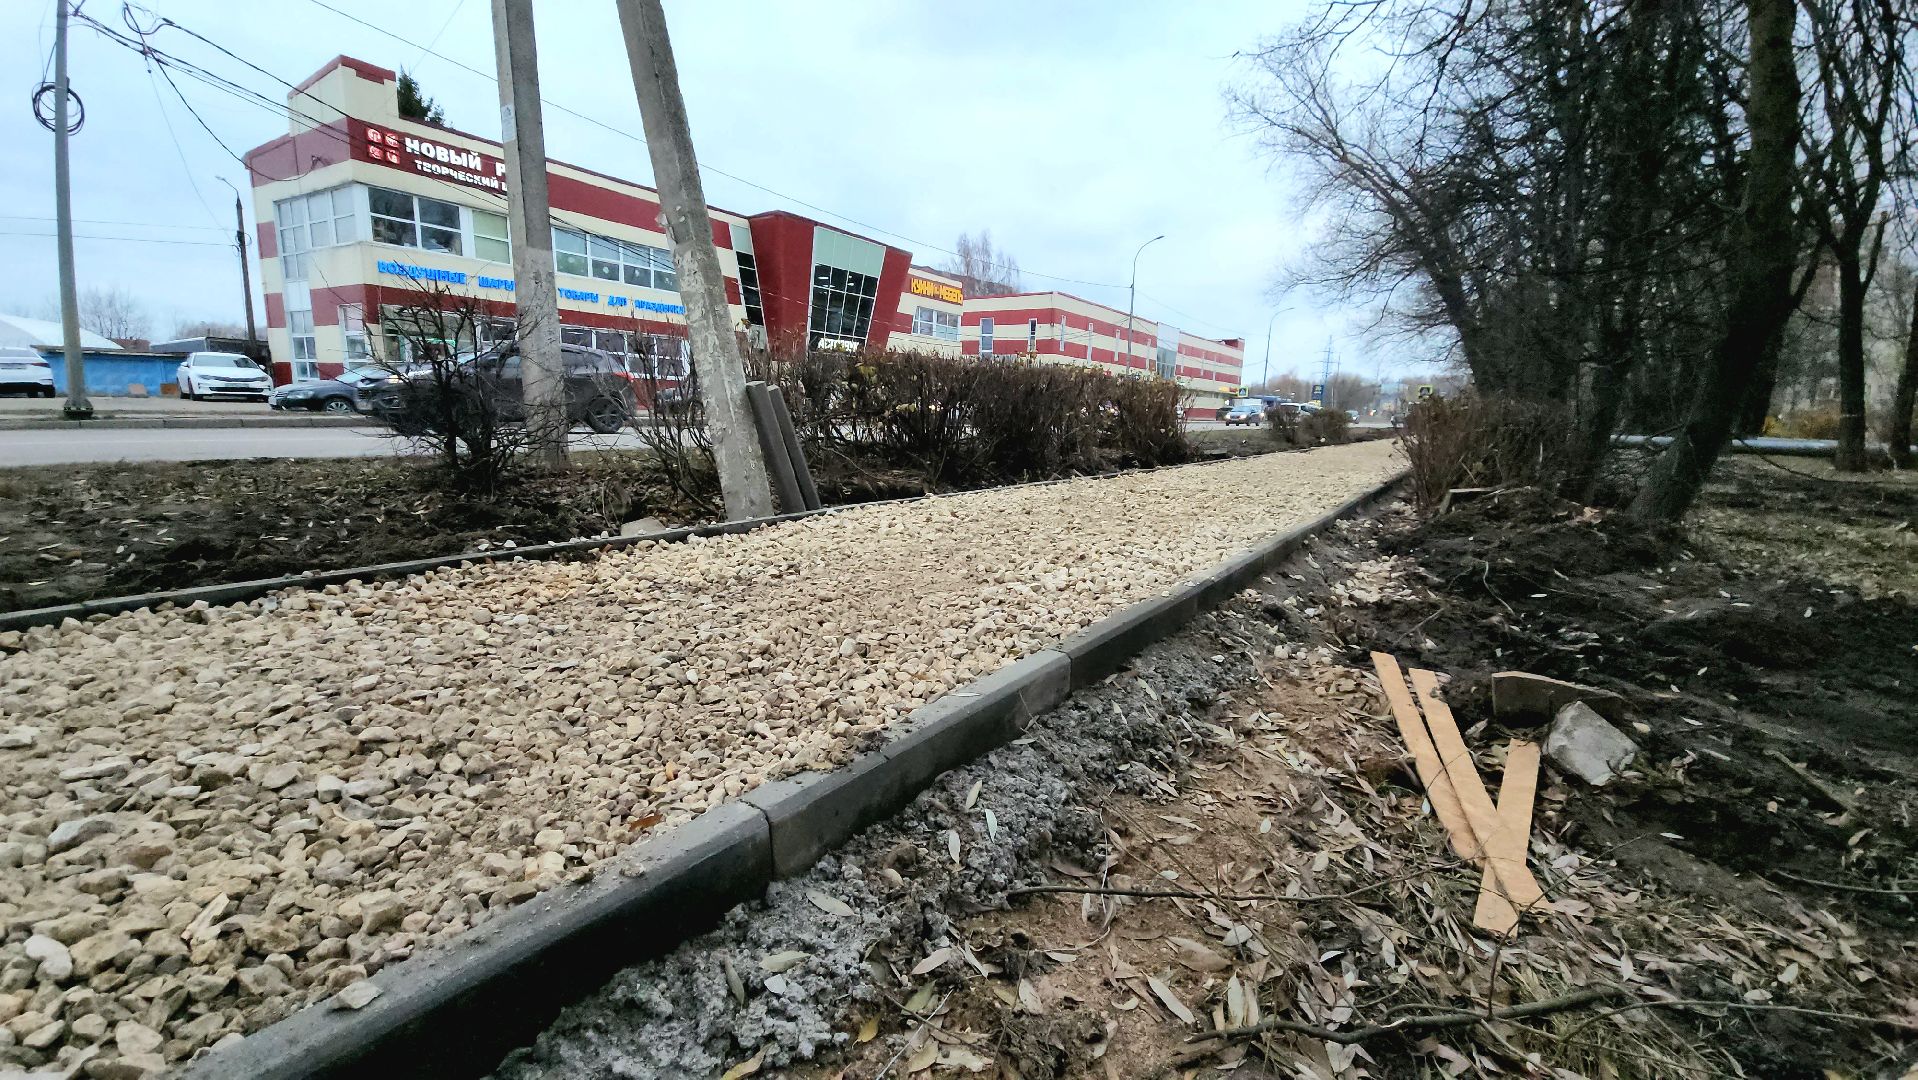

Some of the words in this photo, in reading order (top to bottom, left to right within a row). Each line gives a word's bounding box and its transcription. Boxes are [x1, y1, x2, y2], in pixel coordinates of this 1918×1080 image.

[404, 137, 482, 171] НОВЫЙ
[415, 160, 499, 189] ТВОРЧЕСКИЙ
[377, 260, 466, 285] ВОЗДУШНЫЕ
[478, 275, 516, 292] ШАРЫ
[558, 287, 599, 304] ТОВАРЫ
